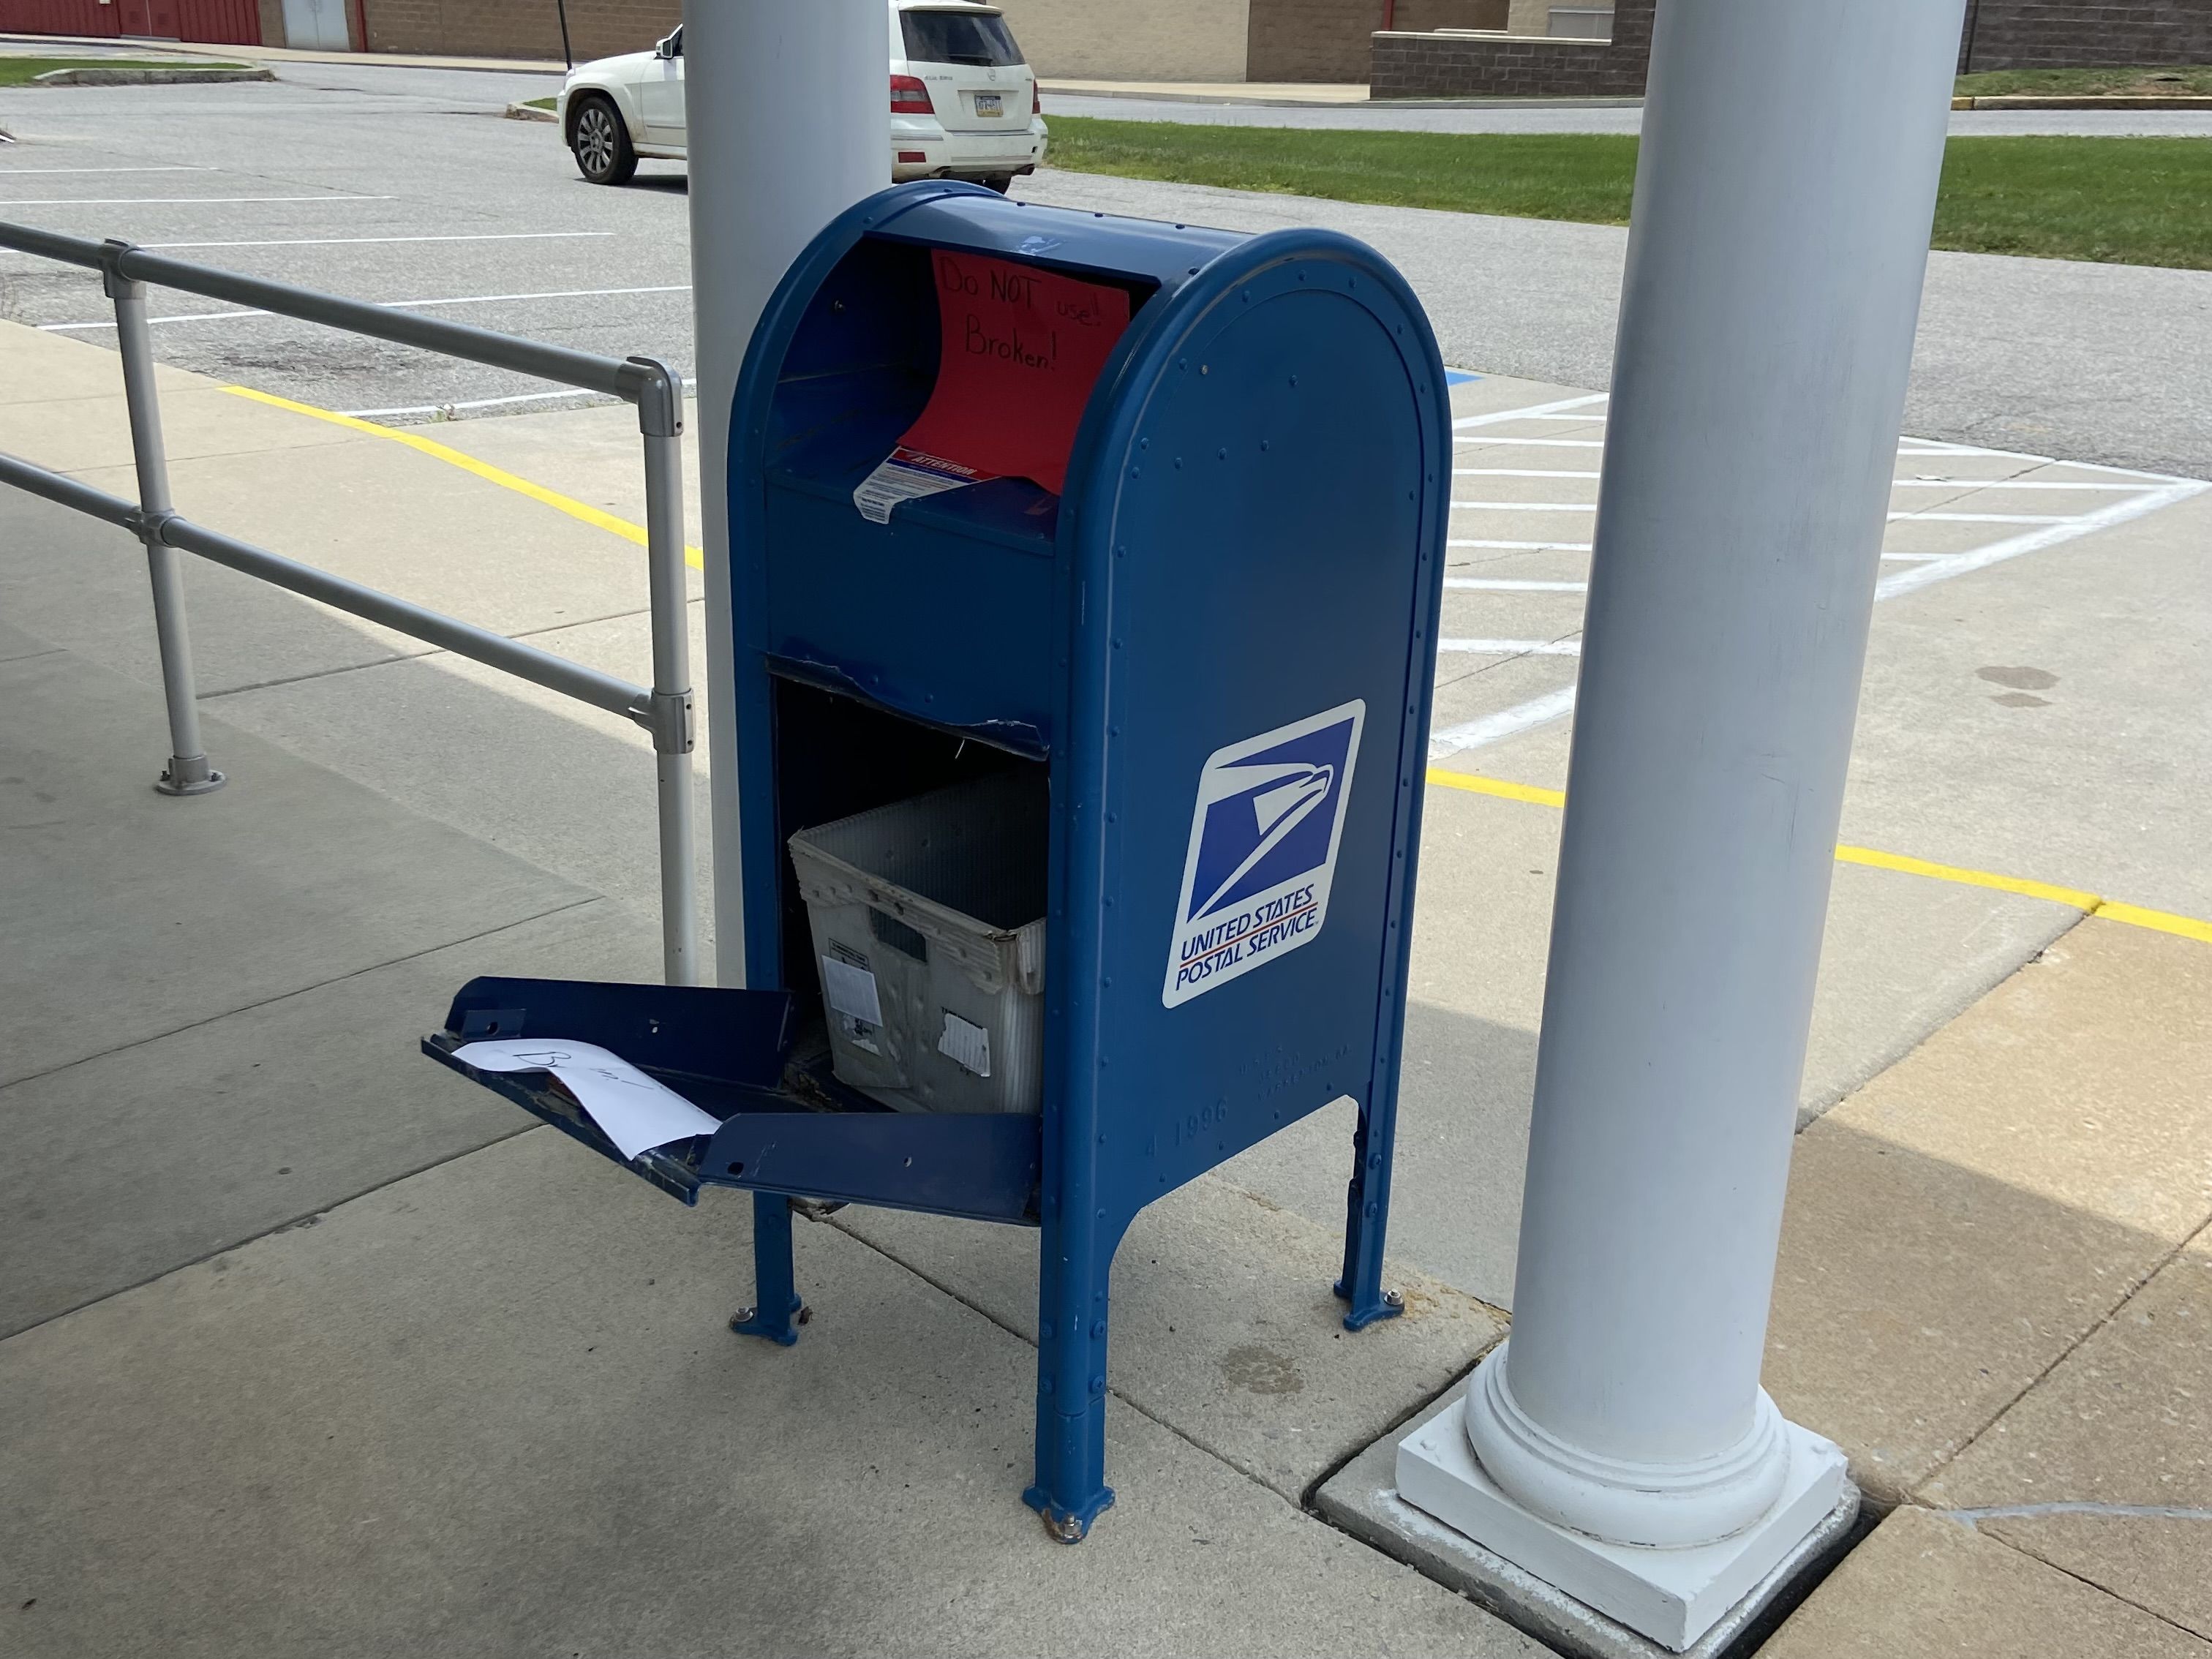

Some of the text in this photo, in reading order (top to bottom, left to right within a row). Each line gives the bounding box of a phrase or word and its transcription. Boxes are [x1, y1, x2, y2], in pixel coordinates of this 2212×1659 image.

[939, 257, 979, 296] Do
[990, 268, 1042, 310] NOT
[965, 312, 1057, 372] Broken!
[911, 455, 978, 475] ATTENTION
[1175, 907, 1317, 991] POSTAL SERVICE
[1181, 883, 1315, 961] UNITED STATES
[1175, 1097, 1230, 1148] 1996
